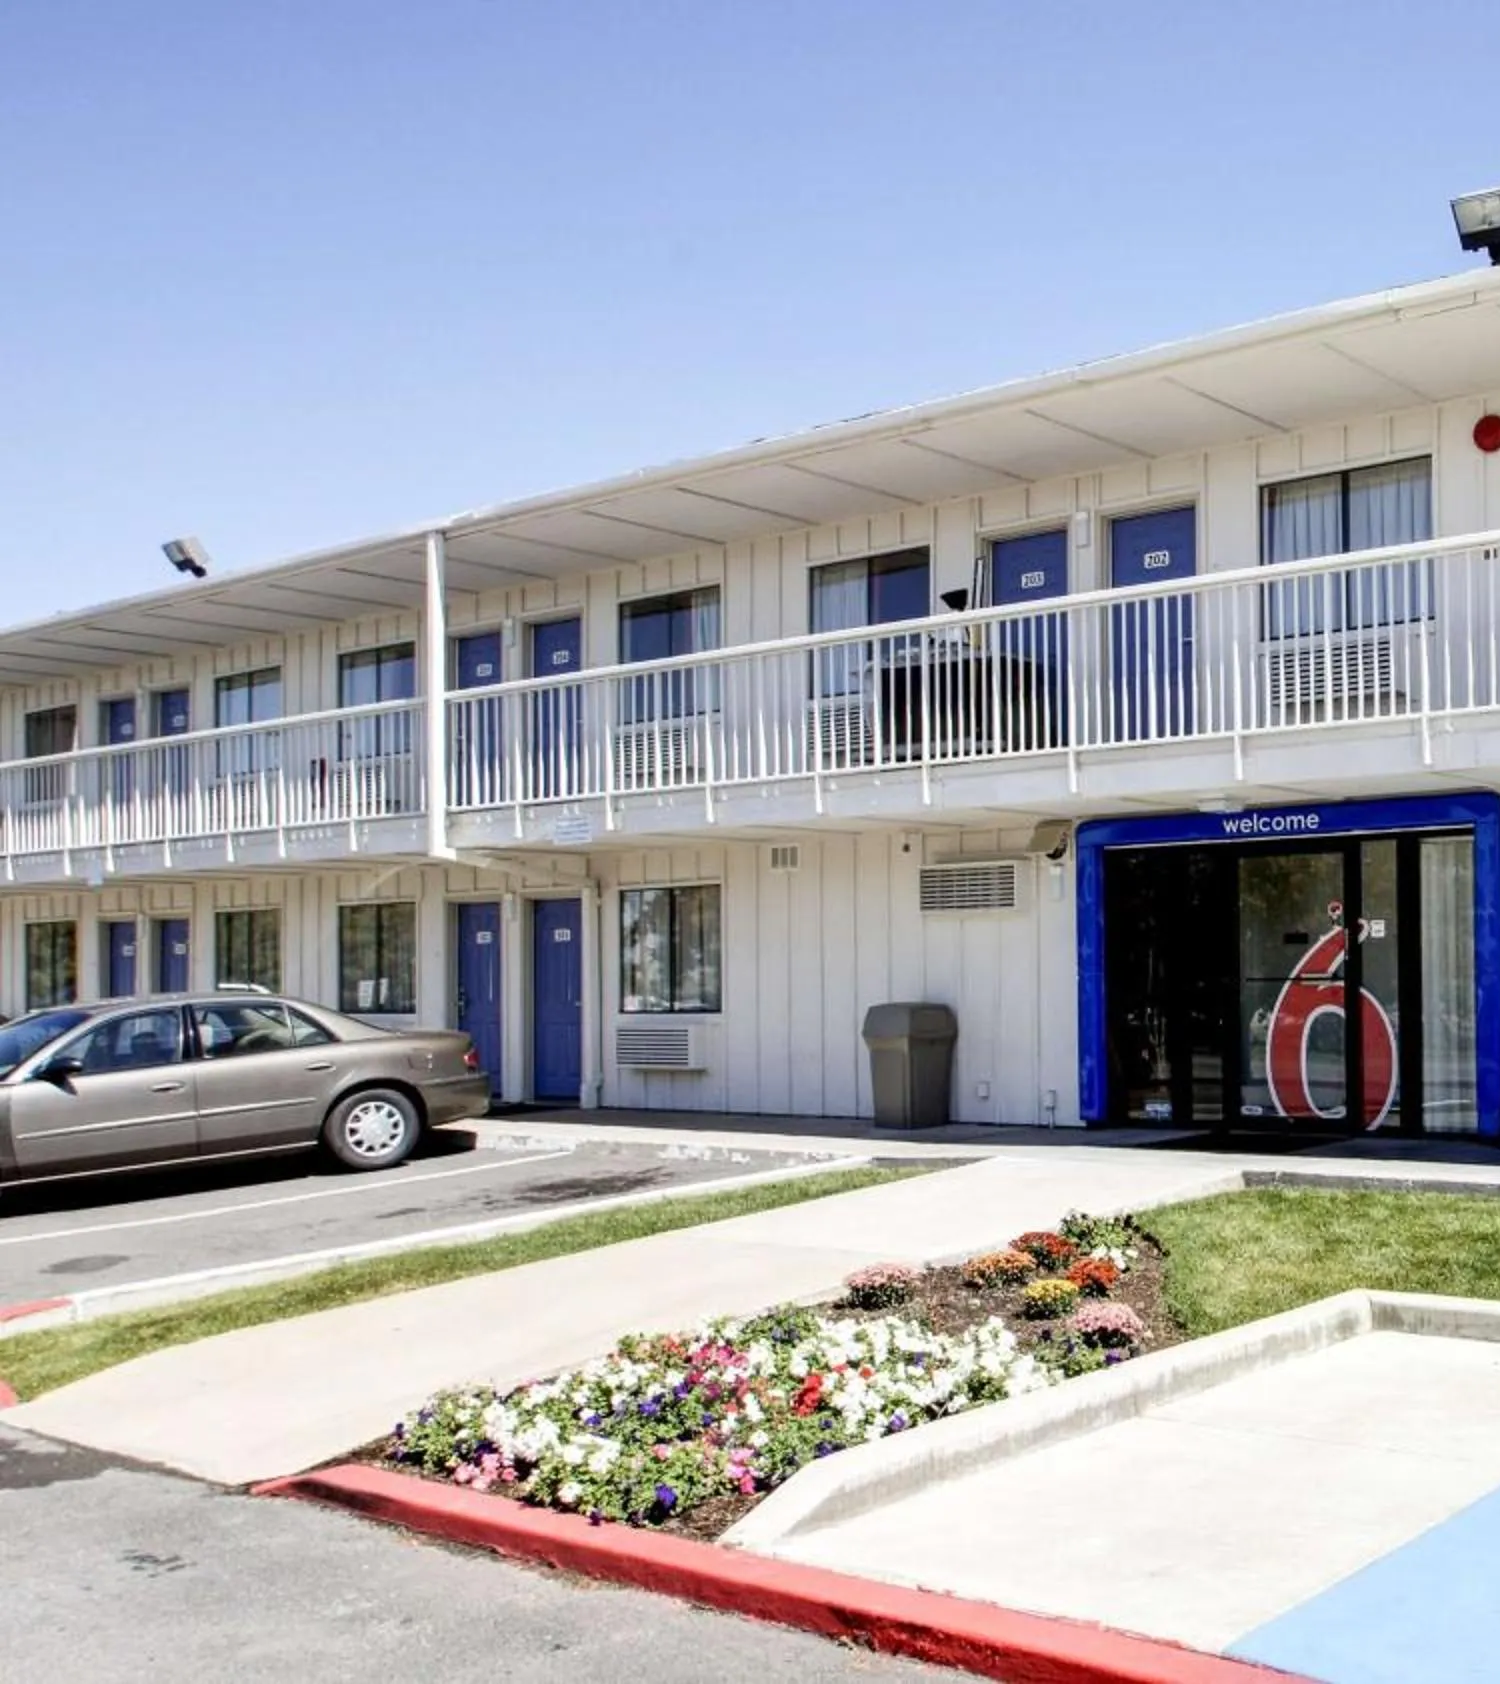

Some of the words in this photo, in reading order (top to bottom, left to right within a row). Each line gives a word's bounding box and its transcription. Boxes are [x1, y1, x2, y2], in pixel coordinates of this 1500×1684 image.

[1147, 552, 1167, 567] 202
[1223, 812, 1320, 833] welcome
[1266, 921, 1398, 1131] 6
